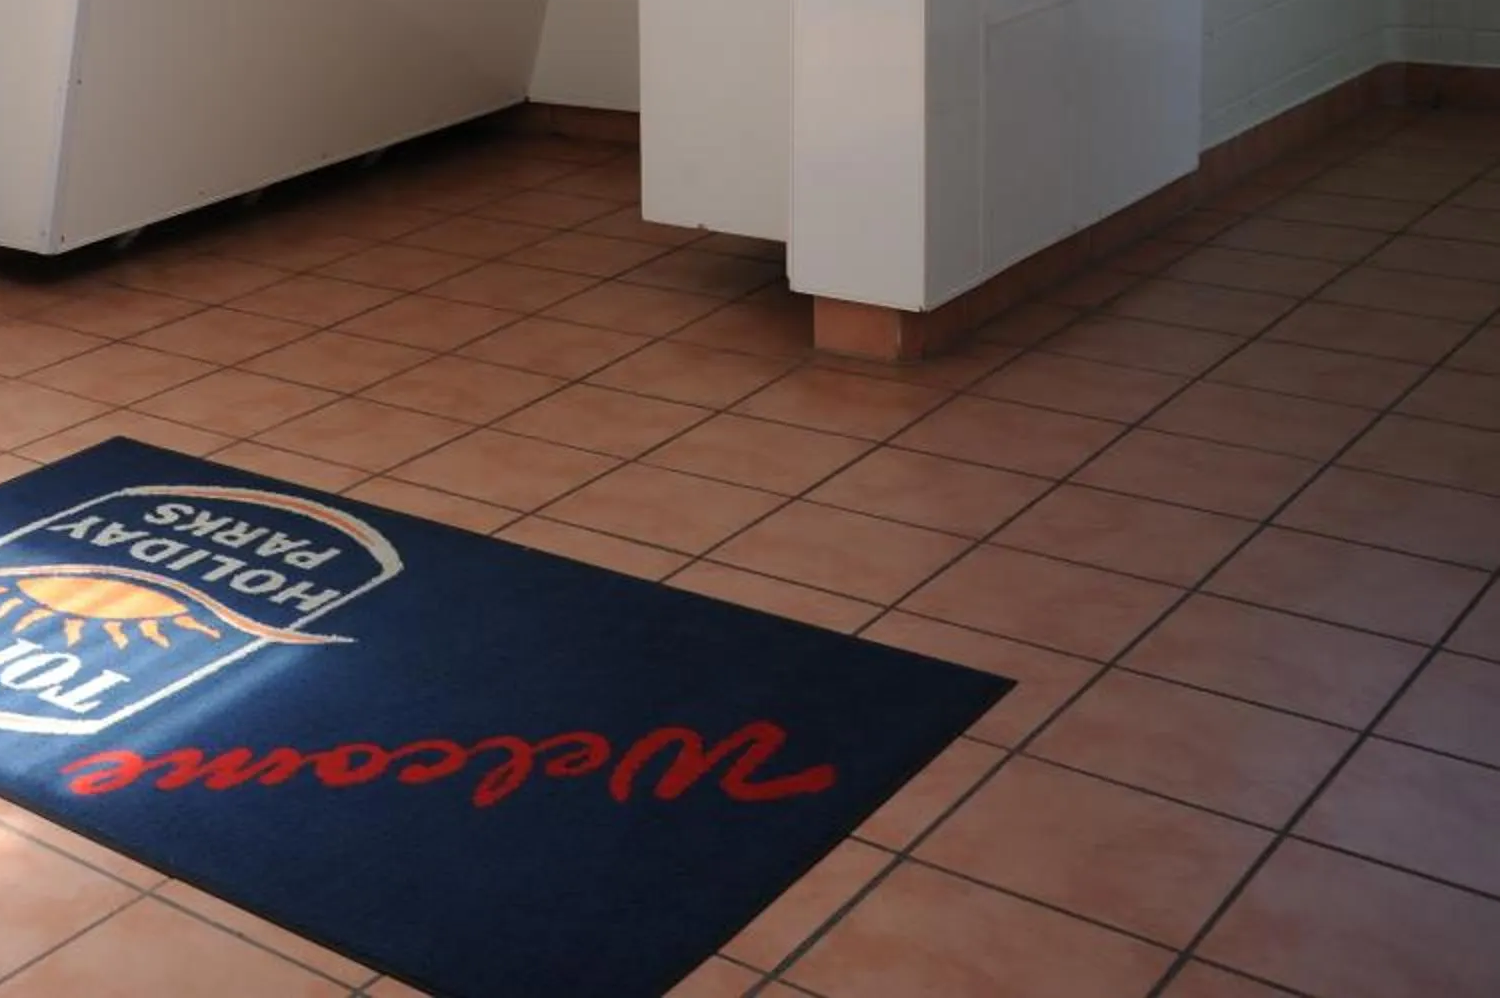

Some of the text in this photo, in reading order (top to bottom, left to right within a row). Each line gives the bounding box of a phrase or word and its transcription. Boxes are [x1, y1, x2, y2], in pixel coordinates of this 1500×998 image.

[48, 515, 347, 614] HOLIDAY
[143, 503, 341, 570] PARKS
[65, 721, 835, 806] Welcome
